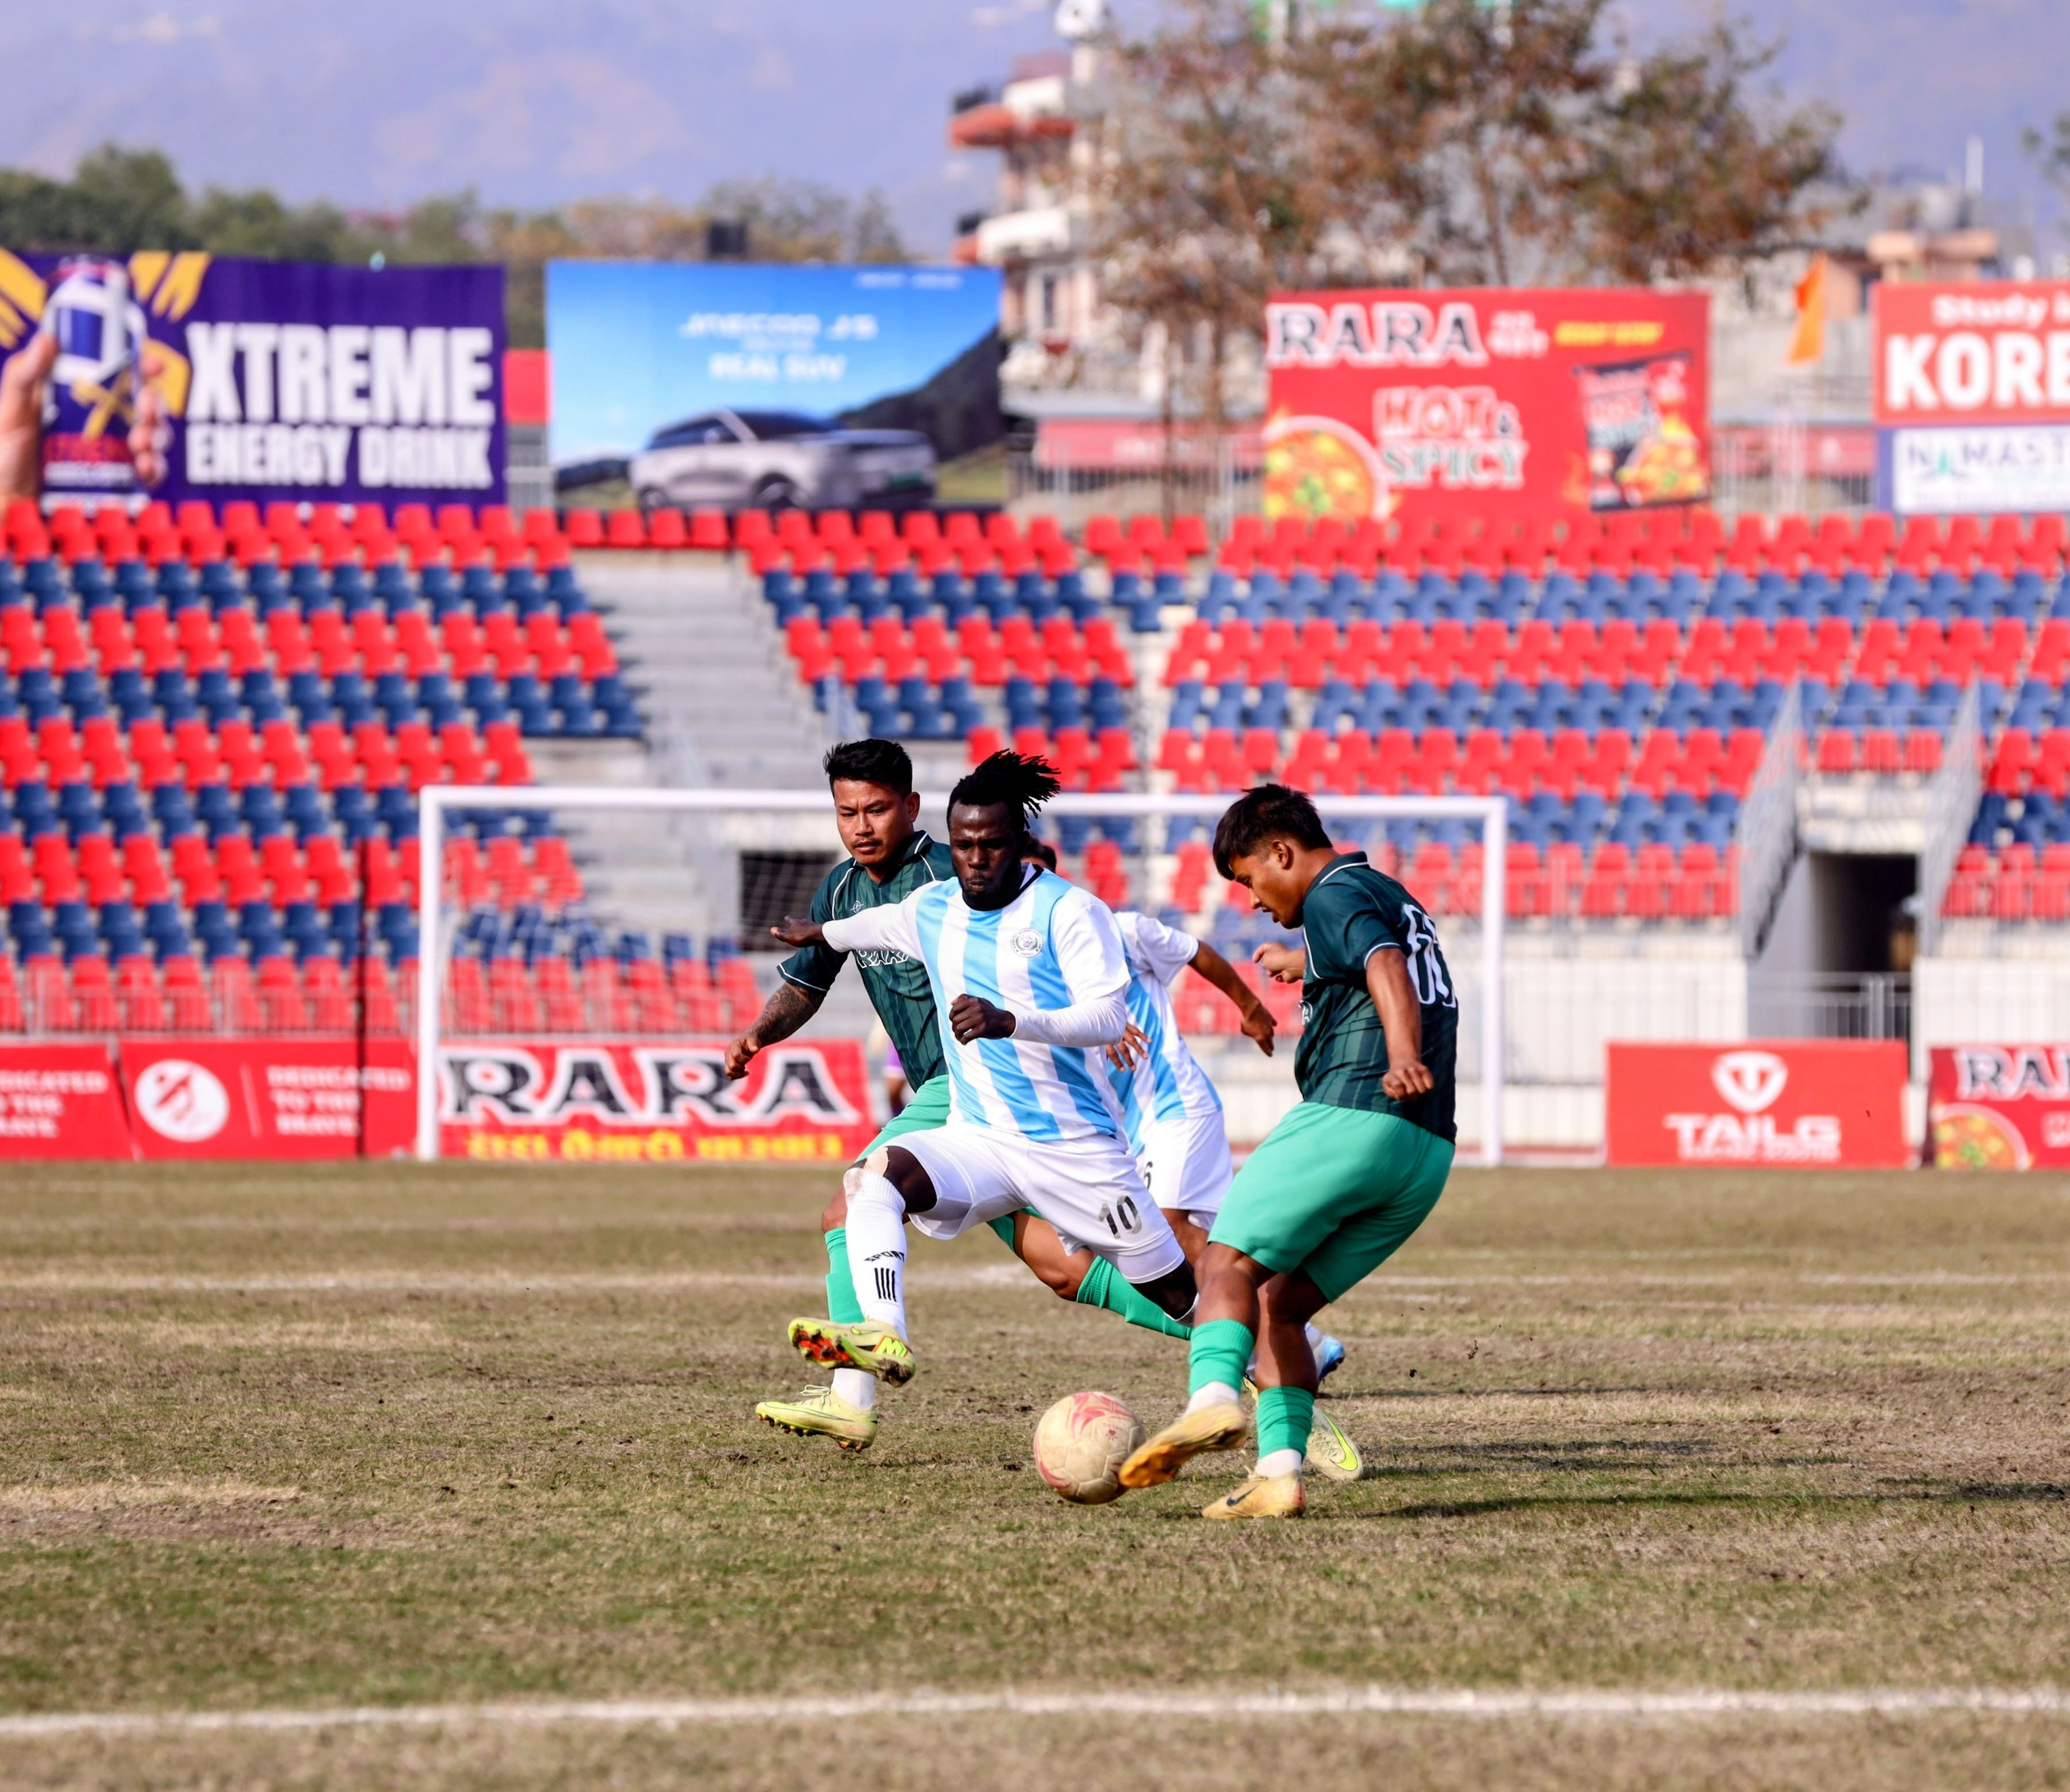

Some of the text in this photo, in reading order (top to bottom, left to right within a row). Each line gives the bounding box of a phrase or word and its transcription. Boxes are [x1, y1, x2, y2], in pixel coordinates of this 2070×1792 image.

[1266, 303, 1489, 366] RARA
[1932, 292, 2048, 330] Study
[185, 322, 495, 427] XTREME
[1373, 386, 1497, 439] HOT
[185, 423, 350, 485] ENERGY
[358, 427, 493, 489] DRINK
[1378, 438, 1528, 490] SPICY
[435, 1048, 861, 1125] RARA
[1663, 1114, 1842, 1147] TAILG
[1098, 1195, 1143, 1239] 10
[864, 1250, 904, 1263] SPORT
